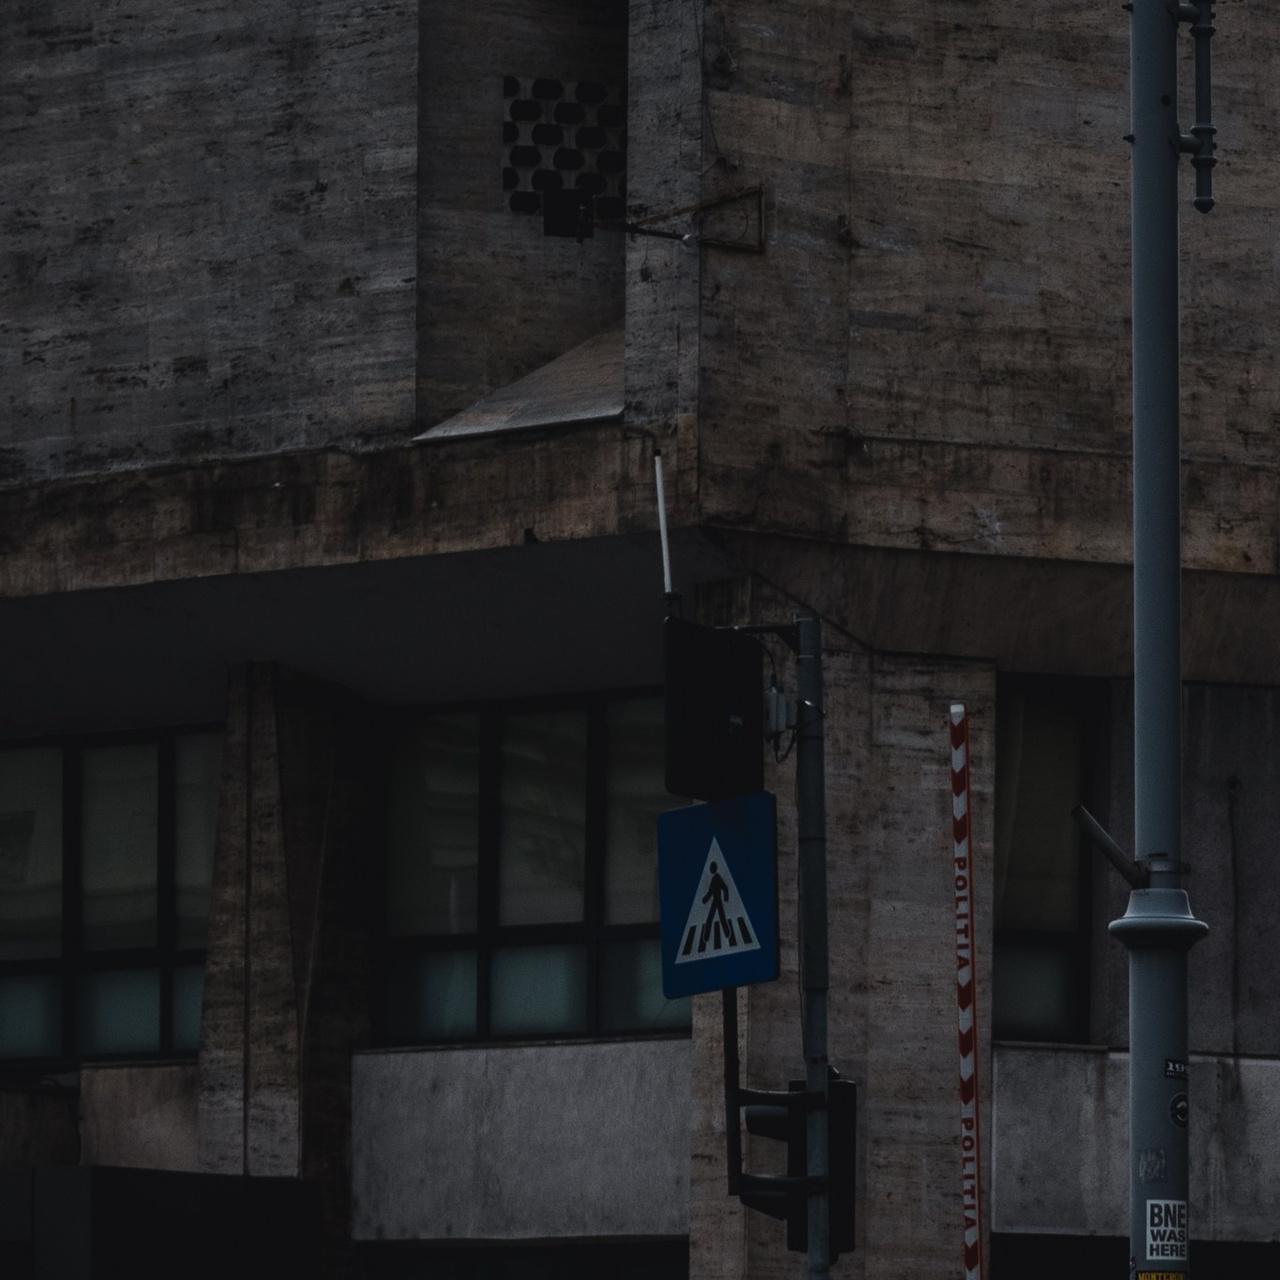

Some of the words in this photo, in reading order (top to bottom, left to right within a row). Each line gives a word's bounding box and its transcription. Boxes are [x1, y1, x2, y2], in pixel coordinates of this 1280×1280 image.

[955, 857, 970, 970] POLITIA
[961, 1117, 976, 1231] POLITIA
[1150, 1203, 1186, 1228] BNE
[1150, 1229, 1186, 1243] WAS
[1149, 1244, 1186, 1257] HERE
